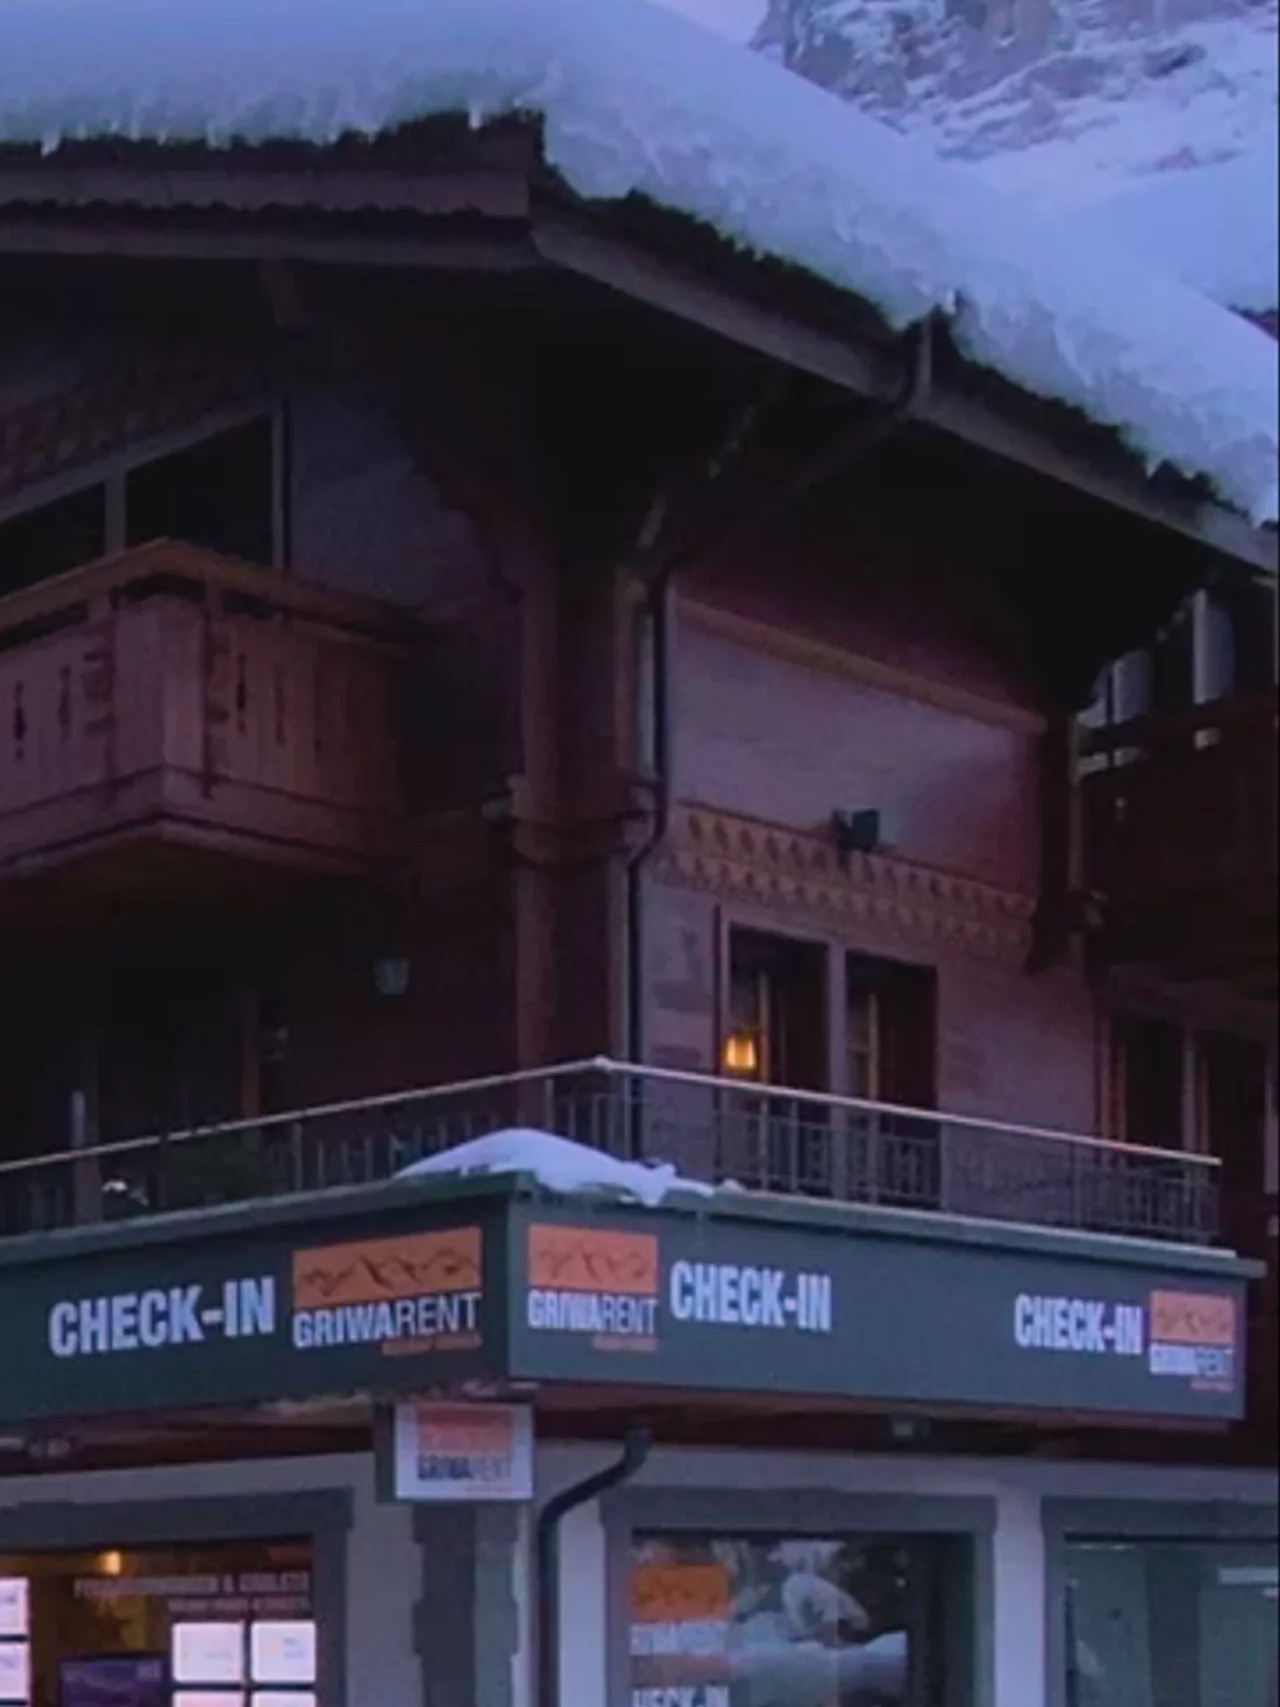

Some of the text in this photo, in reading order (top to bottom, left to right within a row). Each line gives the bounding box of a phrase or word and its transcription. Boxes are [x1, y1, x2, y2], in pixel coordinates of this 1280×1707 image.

[49, 1276, 482, 1356] CHECK-IN GRIWARENT
[527, 1259, 833, 1335] GRIWARENT CHECK-IN
[1014, 1293, 1143, 1355] CHECK-IN
